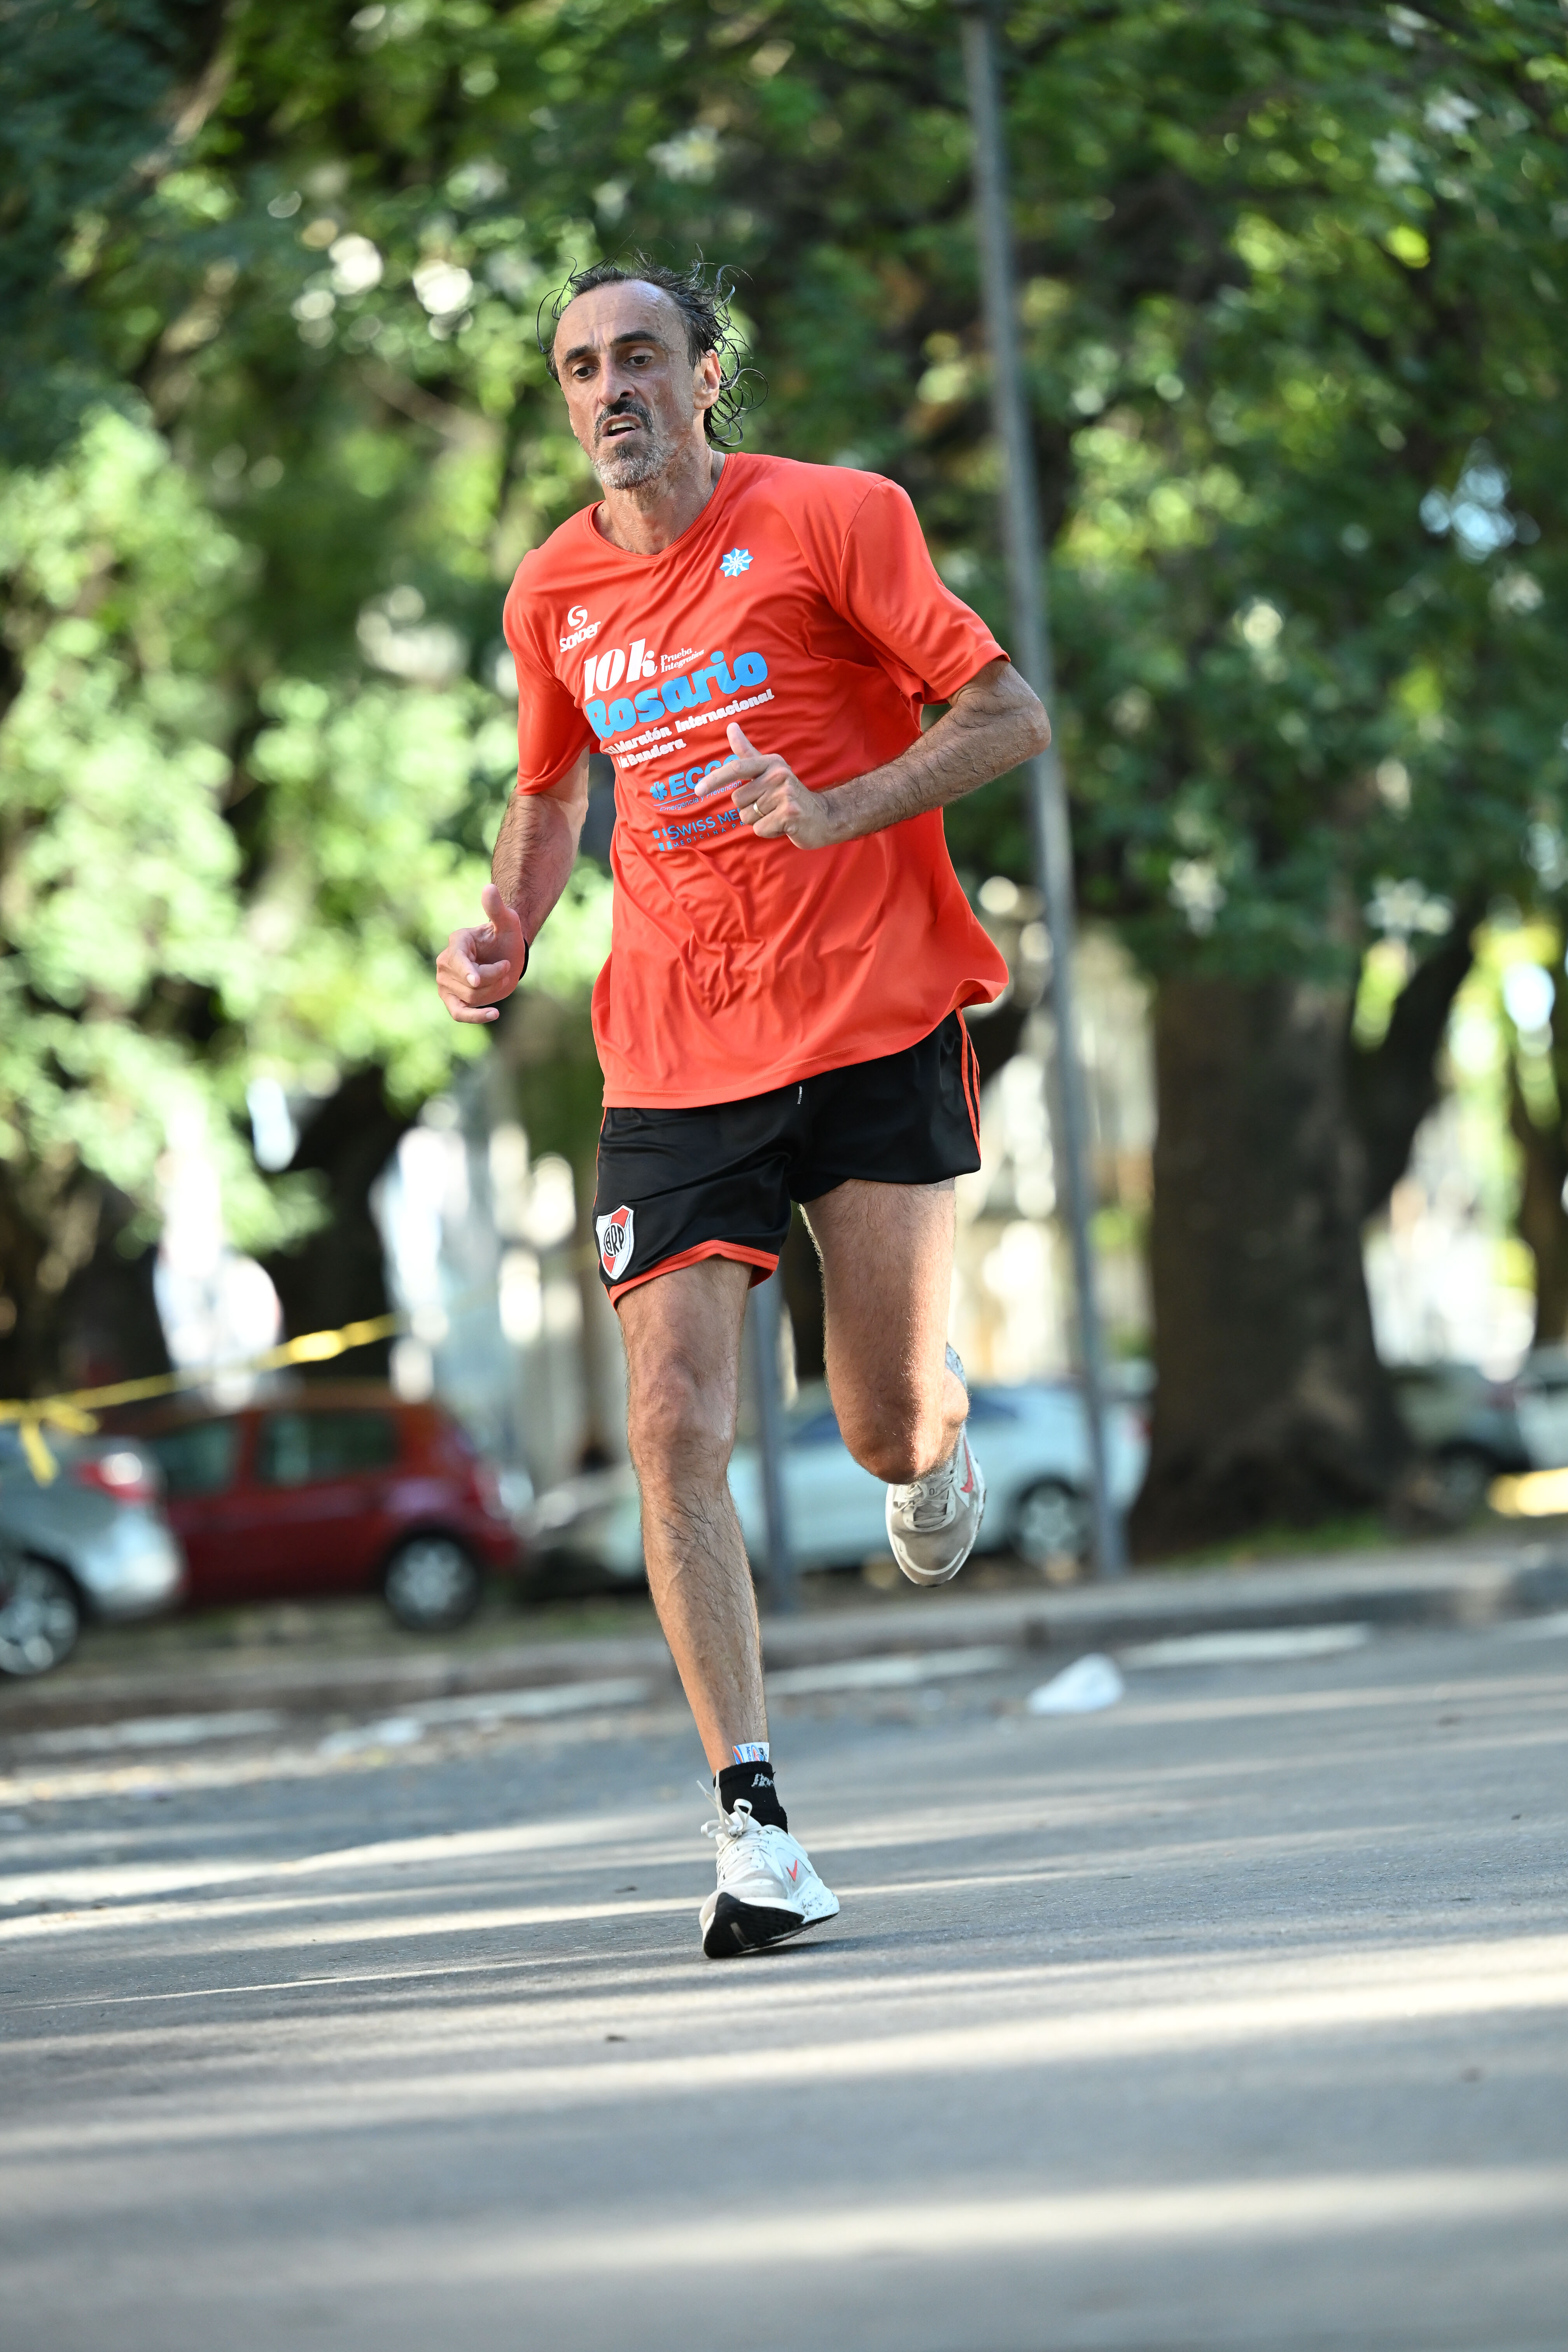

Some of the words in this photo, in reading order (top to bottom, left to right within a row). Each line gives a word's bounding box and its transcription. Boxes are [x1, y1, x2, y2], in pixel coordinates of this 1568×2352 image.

[660, 648, 693, 664] Prueba
[660, 649, 704, 673] Integrativa
[584, 638, 658, 702] 10k
[586, 651, 768, 741] Rosario
[613, 726, 672, 754] Maratón
[675, 688, 775, 733] Internacional
[626, 738, 687, 766] Bandera
[659, 797, 699, 812] Emergencia
[667, 816, 716, 840] SWISS
[673, 827, 726, 848] MEDICINA
